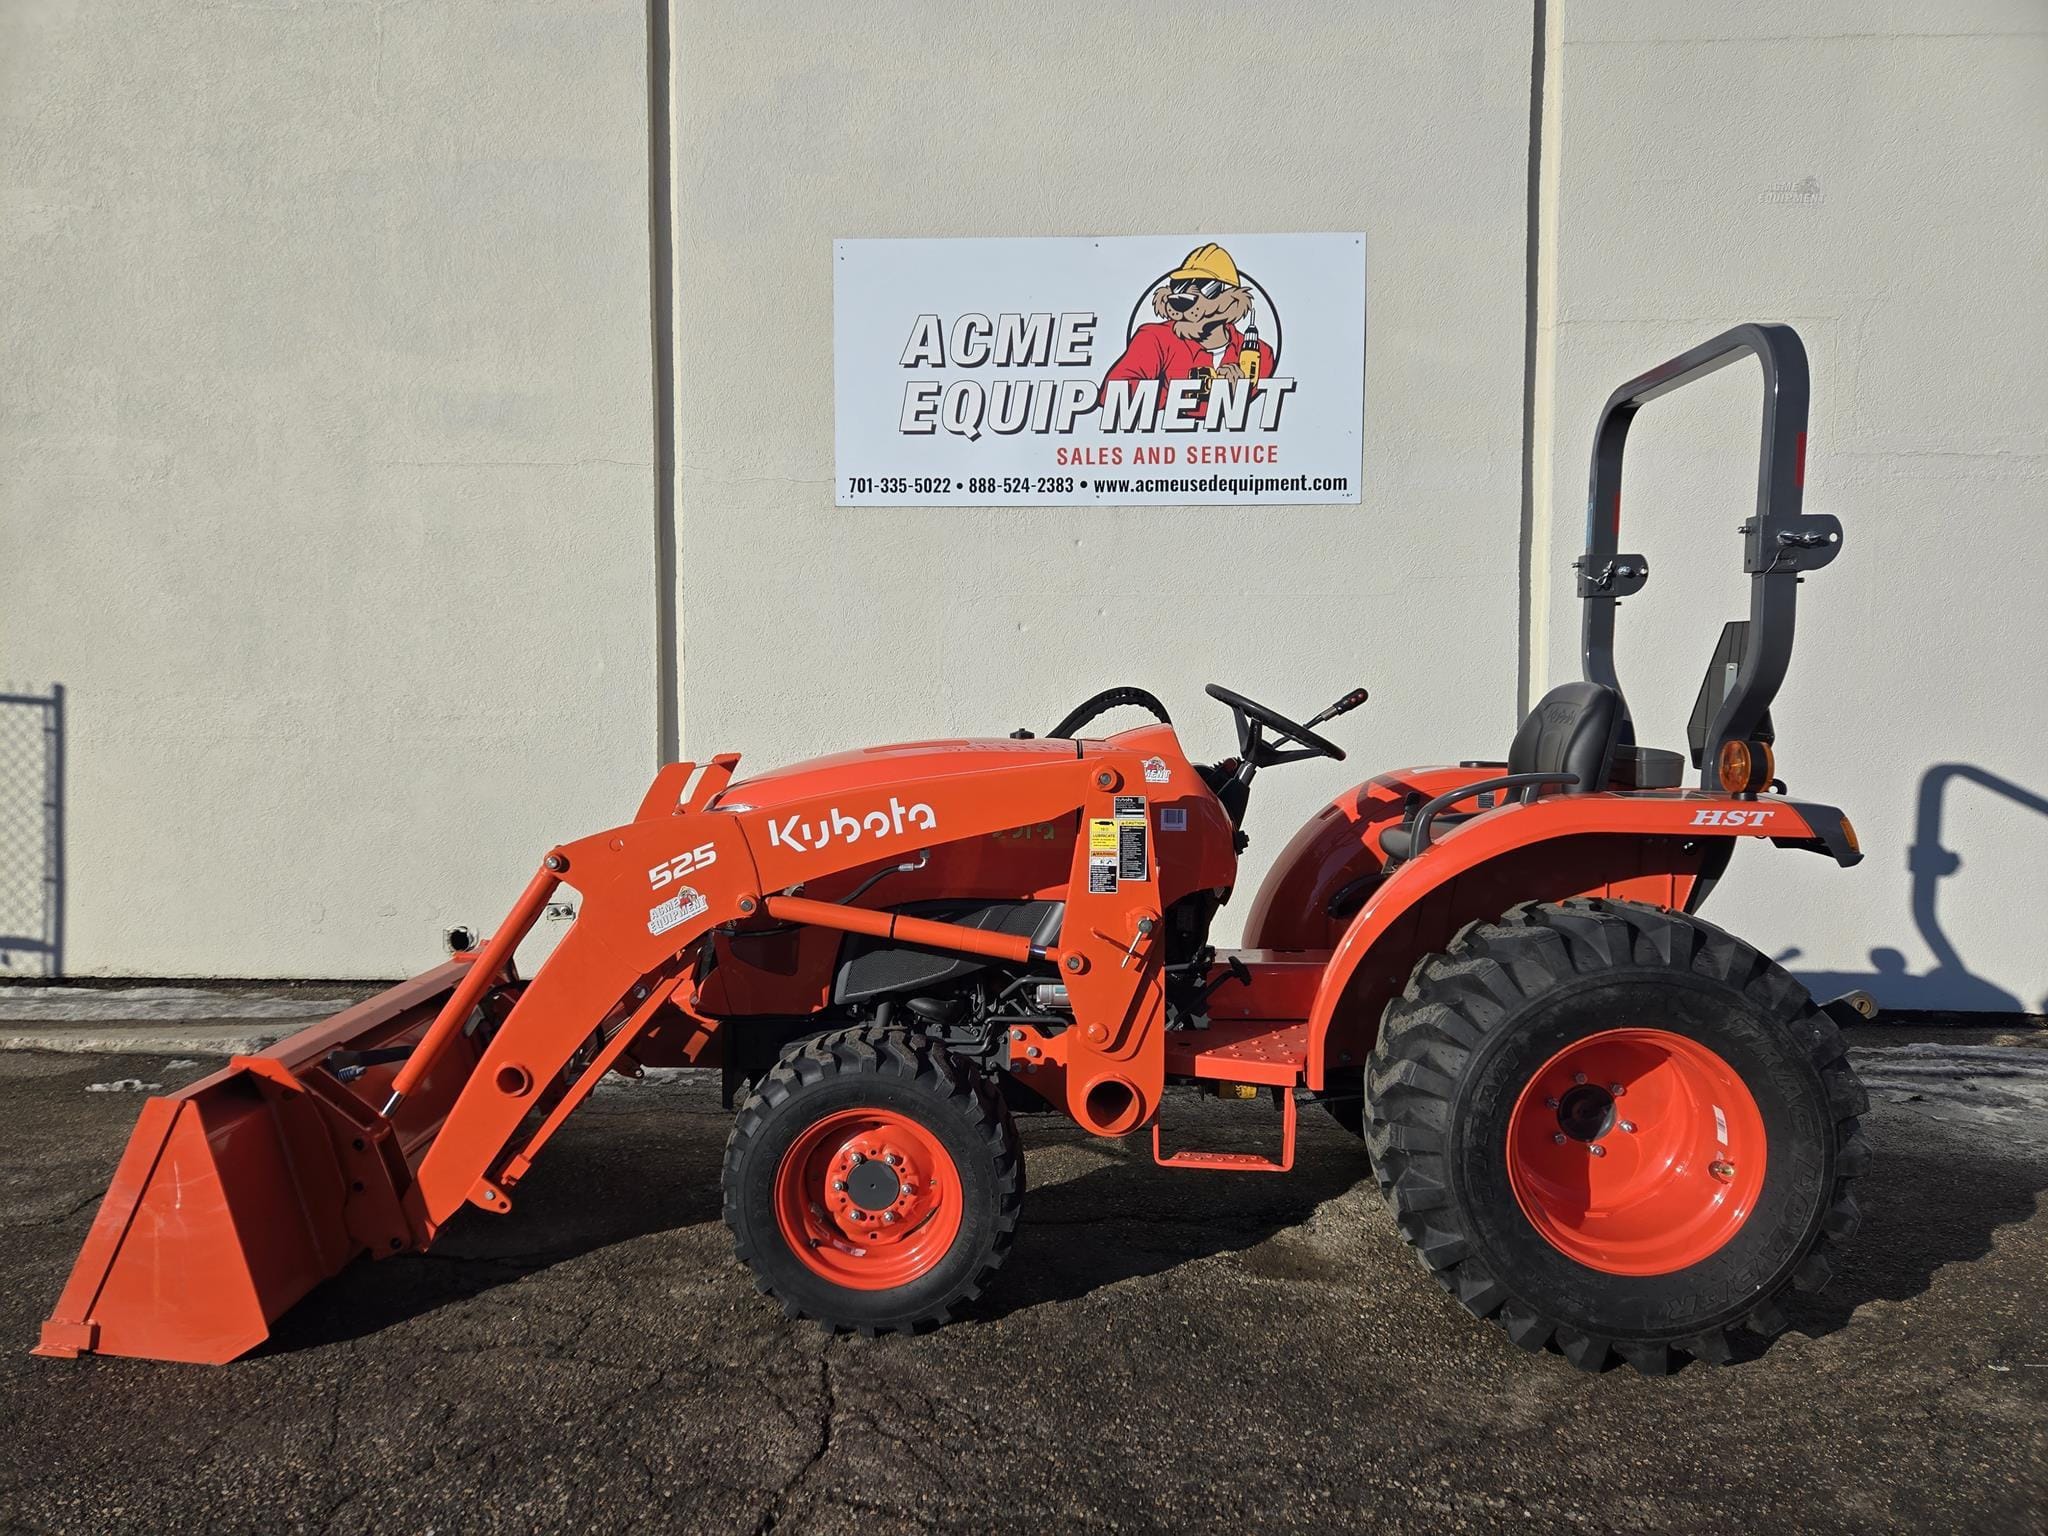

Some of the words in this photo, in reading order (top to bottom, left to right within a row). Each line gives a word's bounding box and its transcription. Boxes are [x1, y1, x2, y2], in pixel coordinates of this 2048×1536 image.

[899, 312, 1097, 368] ACME
[899, 377, 1296, 441] EQUIPMENT
[1057, 447, 1123, 466] SALES
[1133, 446, 1176, 465] AND
[1187, 445, 1279, 464] SERVICE
[849, 477, 951, 494] 701-335-5022
[969, 477, 1074, 494] 888-524-2383
[1094, 474, 1348, 496] www.acmeusedequipment.com
[768, 797, 937, 852] Kubota
[1689, 810, 1775, 827] HST
[648, 842, 717, 891] 525
[650, 895, 708, 932] EQUIPMENT
[652, 897, 680, 920] ACME
